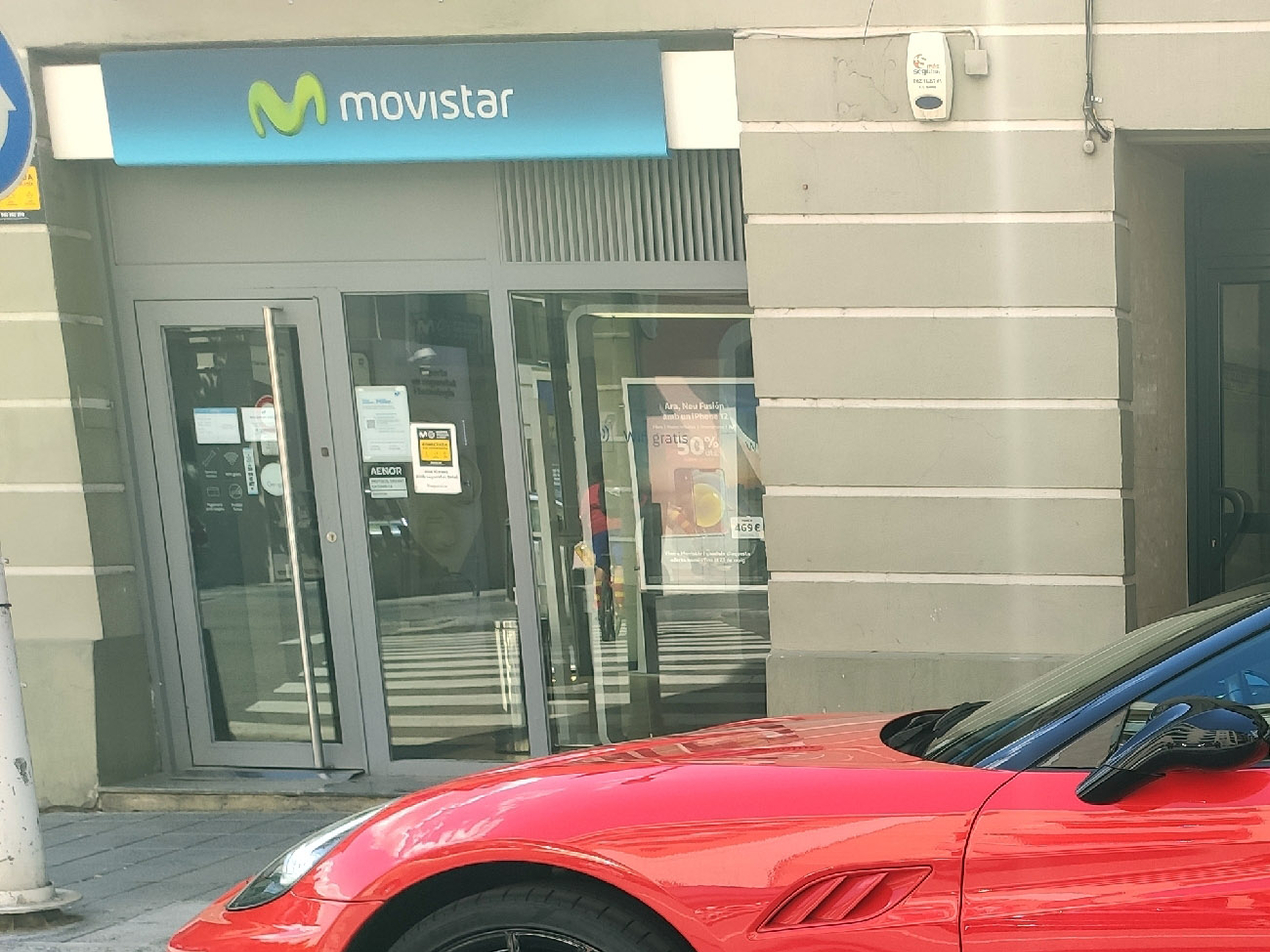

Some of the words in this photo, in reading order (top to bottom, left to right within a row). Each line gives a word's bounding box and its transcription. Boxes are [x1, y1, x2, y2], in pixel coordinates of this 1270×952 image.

[339, 84, 514, 122] movistar
[652, 431, 689, 447] gratis
[370, 466, 402, 476] AENOR
